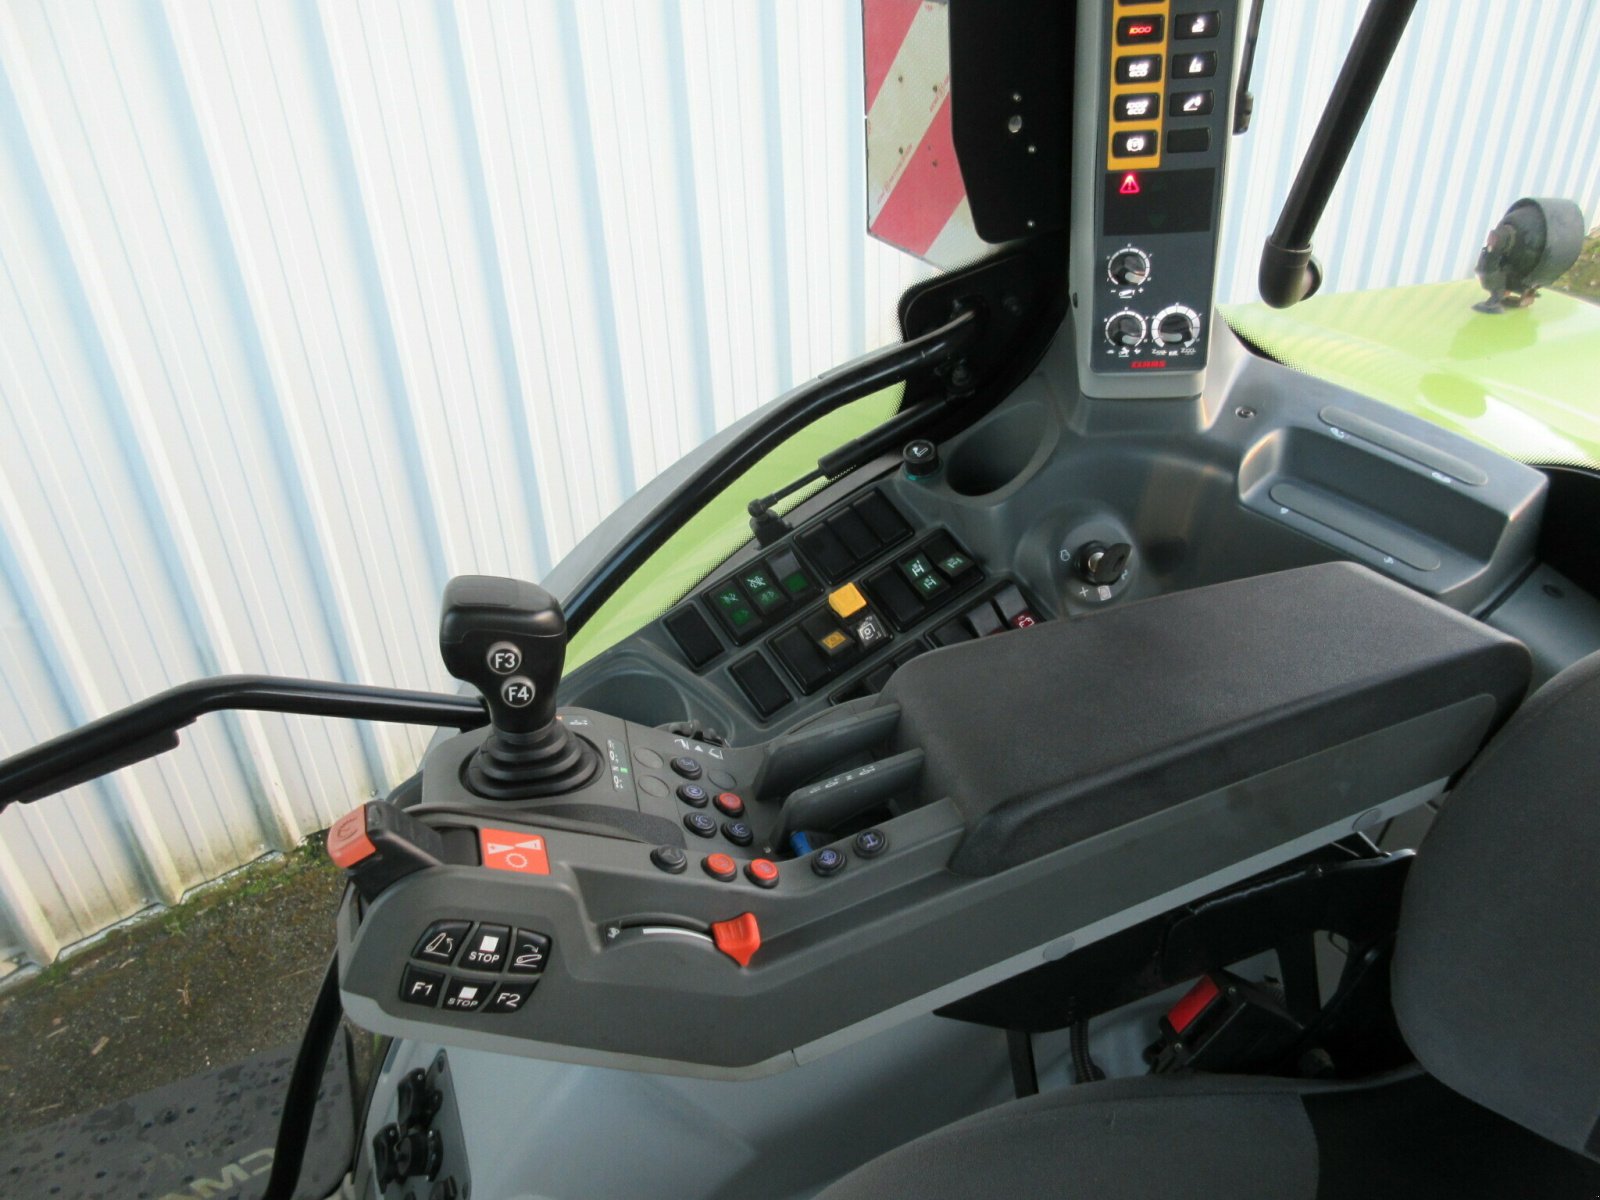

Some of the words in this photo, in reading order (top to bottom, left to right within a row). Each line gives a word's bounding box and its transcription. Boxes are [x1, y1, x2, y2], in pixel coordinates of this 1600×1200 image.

[495, 653, 516, 669] F3
[508, 686, 530, 702] F4
[468, 952, 500, 963] STOP
[411, 982, 434, 996] F1
[447, 997, 479, 1007] STOP
[497, 993, 521, 1007] F2
